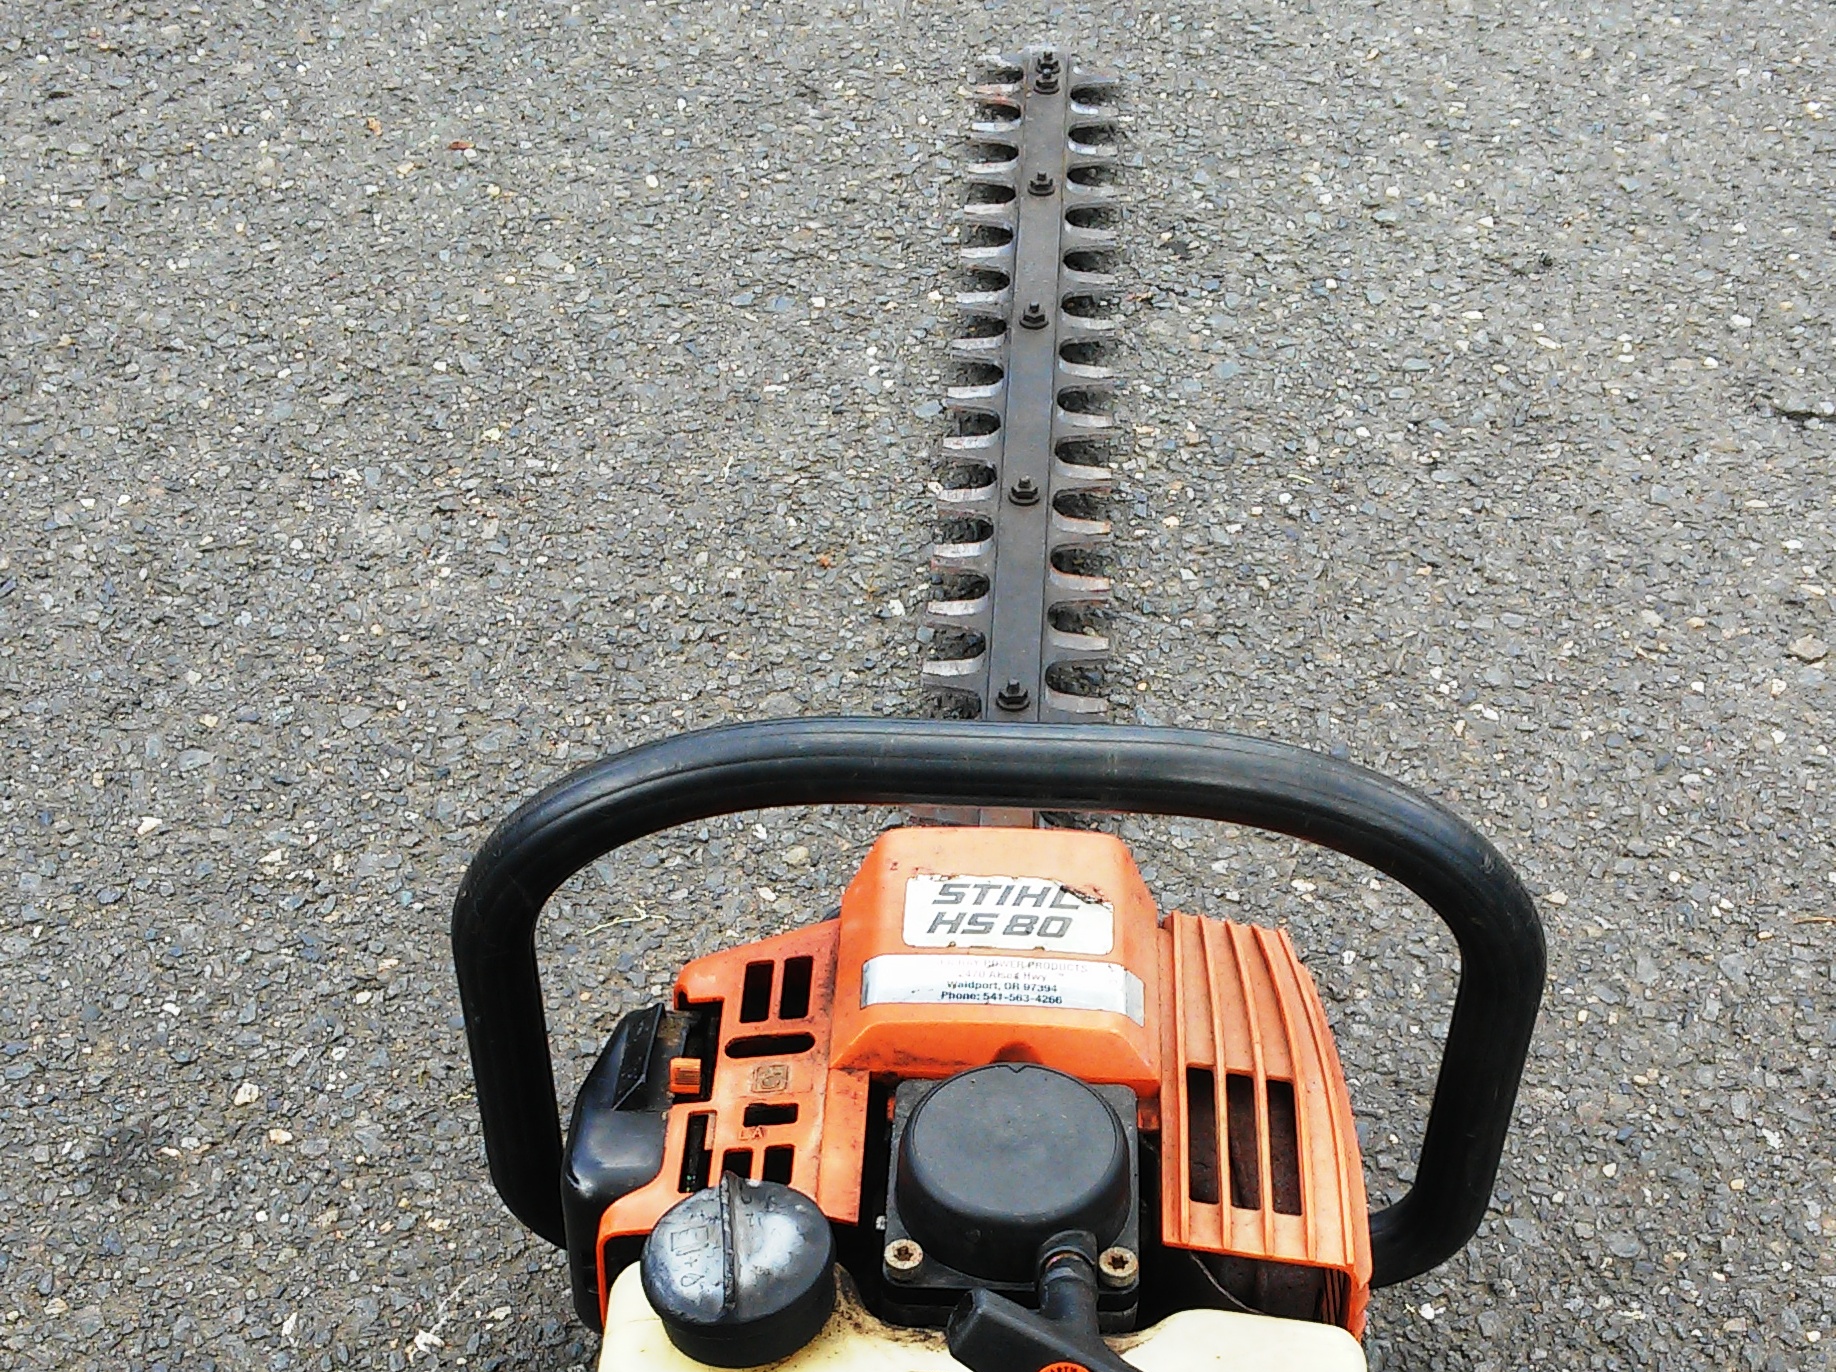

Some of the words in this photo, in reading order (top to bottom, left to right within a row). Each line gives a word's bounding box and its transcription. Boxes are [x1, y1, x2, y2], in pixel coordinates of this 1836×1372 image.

[932, 883, 1081, 910] STIHL
[1027, 961, 1089, 974] PRODUCTS
[1023, 973, 1047, 982] Hwy
[1004, 982, 1020, 991] OR
[940, 991, 980, 1001] Phone:
